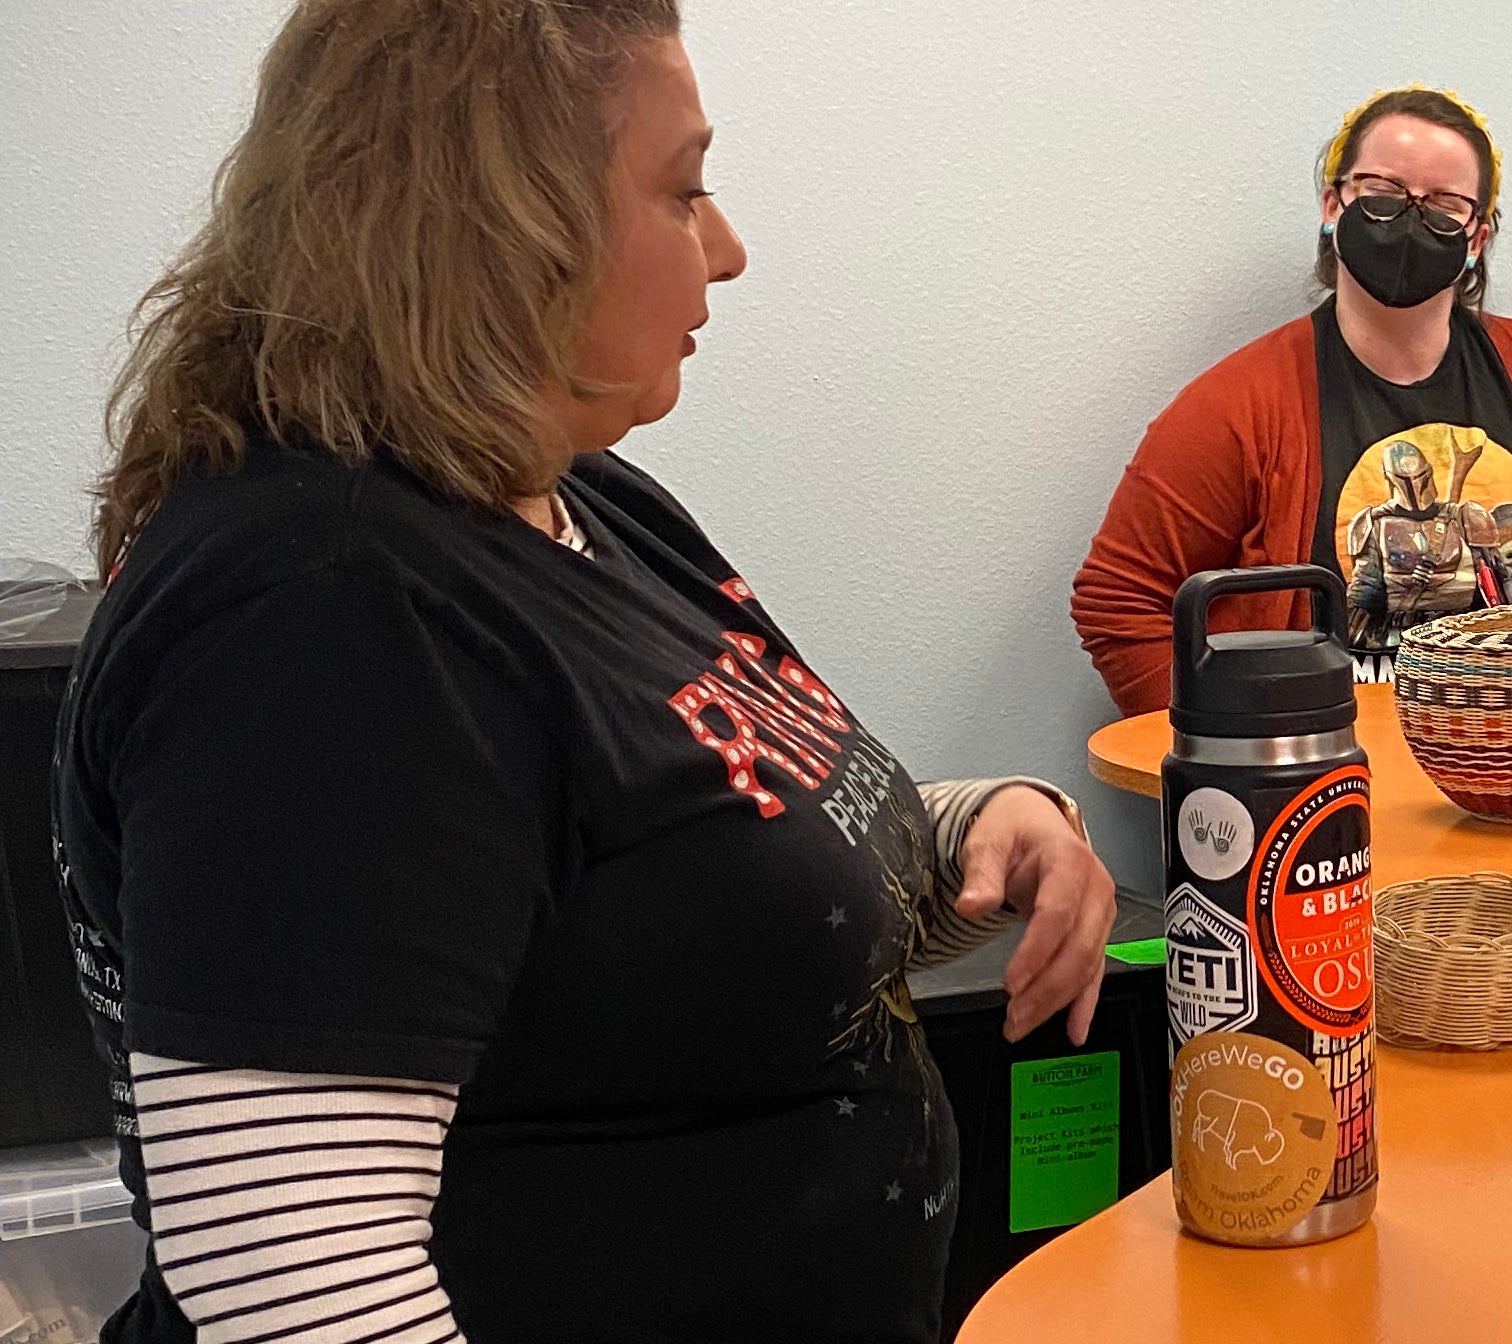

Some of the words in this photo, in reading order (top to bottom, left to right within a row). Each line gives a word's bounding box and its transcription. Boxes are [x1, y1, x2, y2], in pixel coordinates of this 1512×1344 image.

[1260, 831, 1289, 906] OKLAHOMA
[1290, 795, 1324, 828] STATE
[1295, 846, 1370, 887] ORANG
[1301, 896, 1318, 918] &
[1323, 877, 1371, 916] BLAC
[1290, 934, 1352, 959] LOYAL
[1167, 947, 1238, 991] YETI
[1313, 950, 1373, 998] OSU
[1180, 999, 1206, 1027] WILD
[1192, 992, 1201, 1001] TO
[1203, 994, 1221, 1003] THE
[1032, 1069, 1073, 1083] BUTTON
[1076, 1065, 1103, 1078] FARM
[1020, 1110, 1043, 1119] Mini
[1013, 1131, 1056, 1145] Project
[1220, 1166, 1321, 1232] Oklahoma
